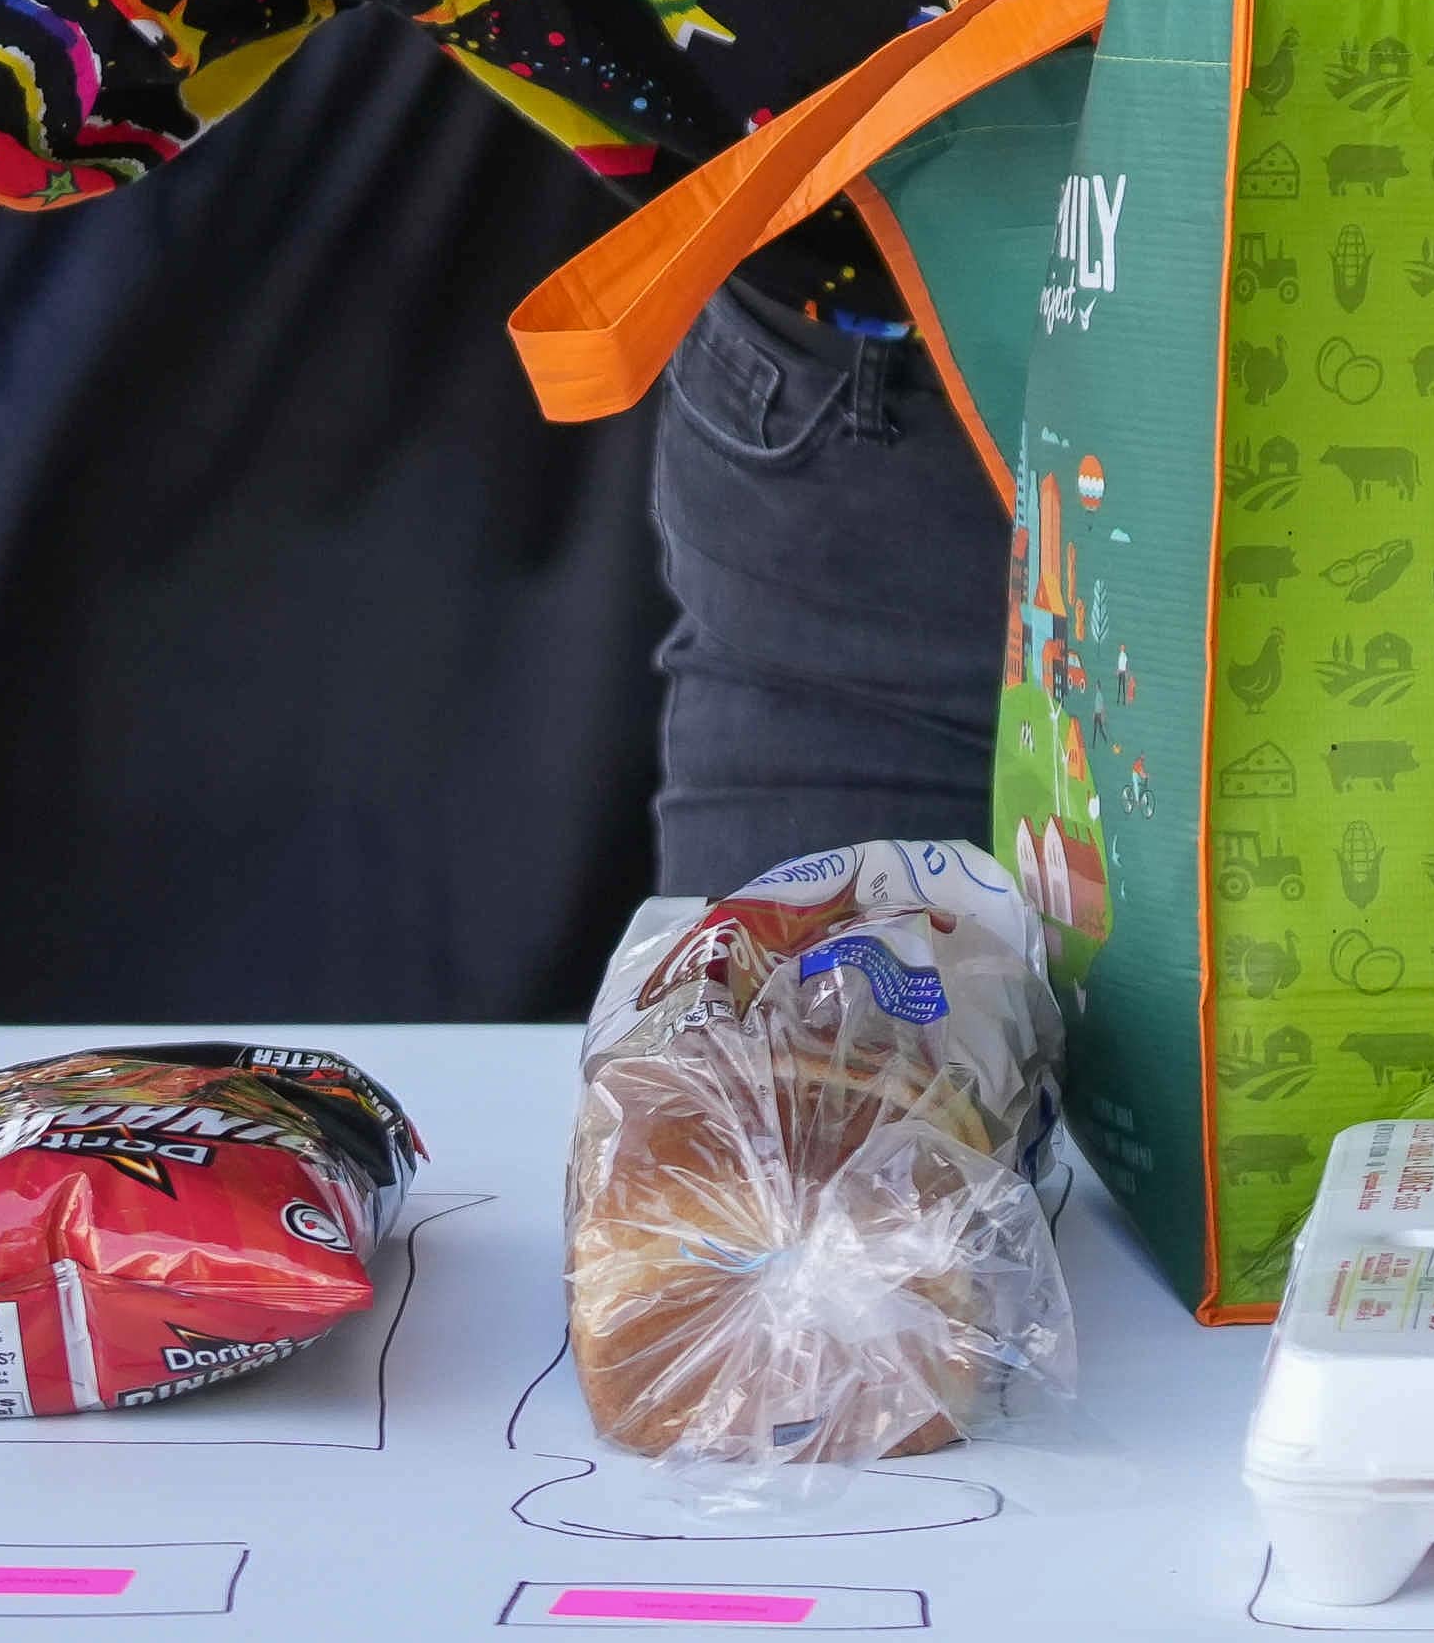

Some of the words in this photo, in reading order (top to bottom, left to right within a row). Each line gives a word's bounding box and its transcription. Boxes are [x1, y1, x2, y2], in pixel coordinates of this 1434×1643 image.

[784, 853, 845, 883] CLASSIC
[33, 1132, 211, 1166] Dorit
[165, 1338, 294, 1371] Doritos
